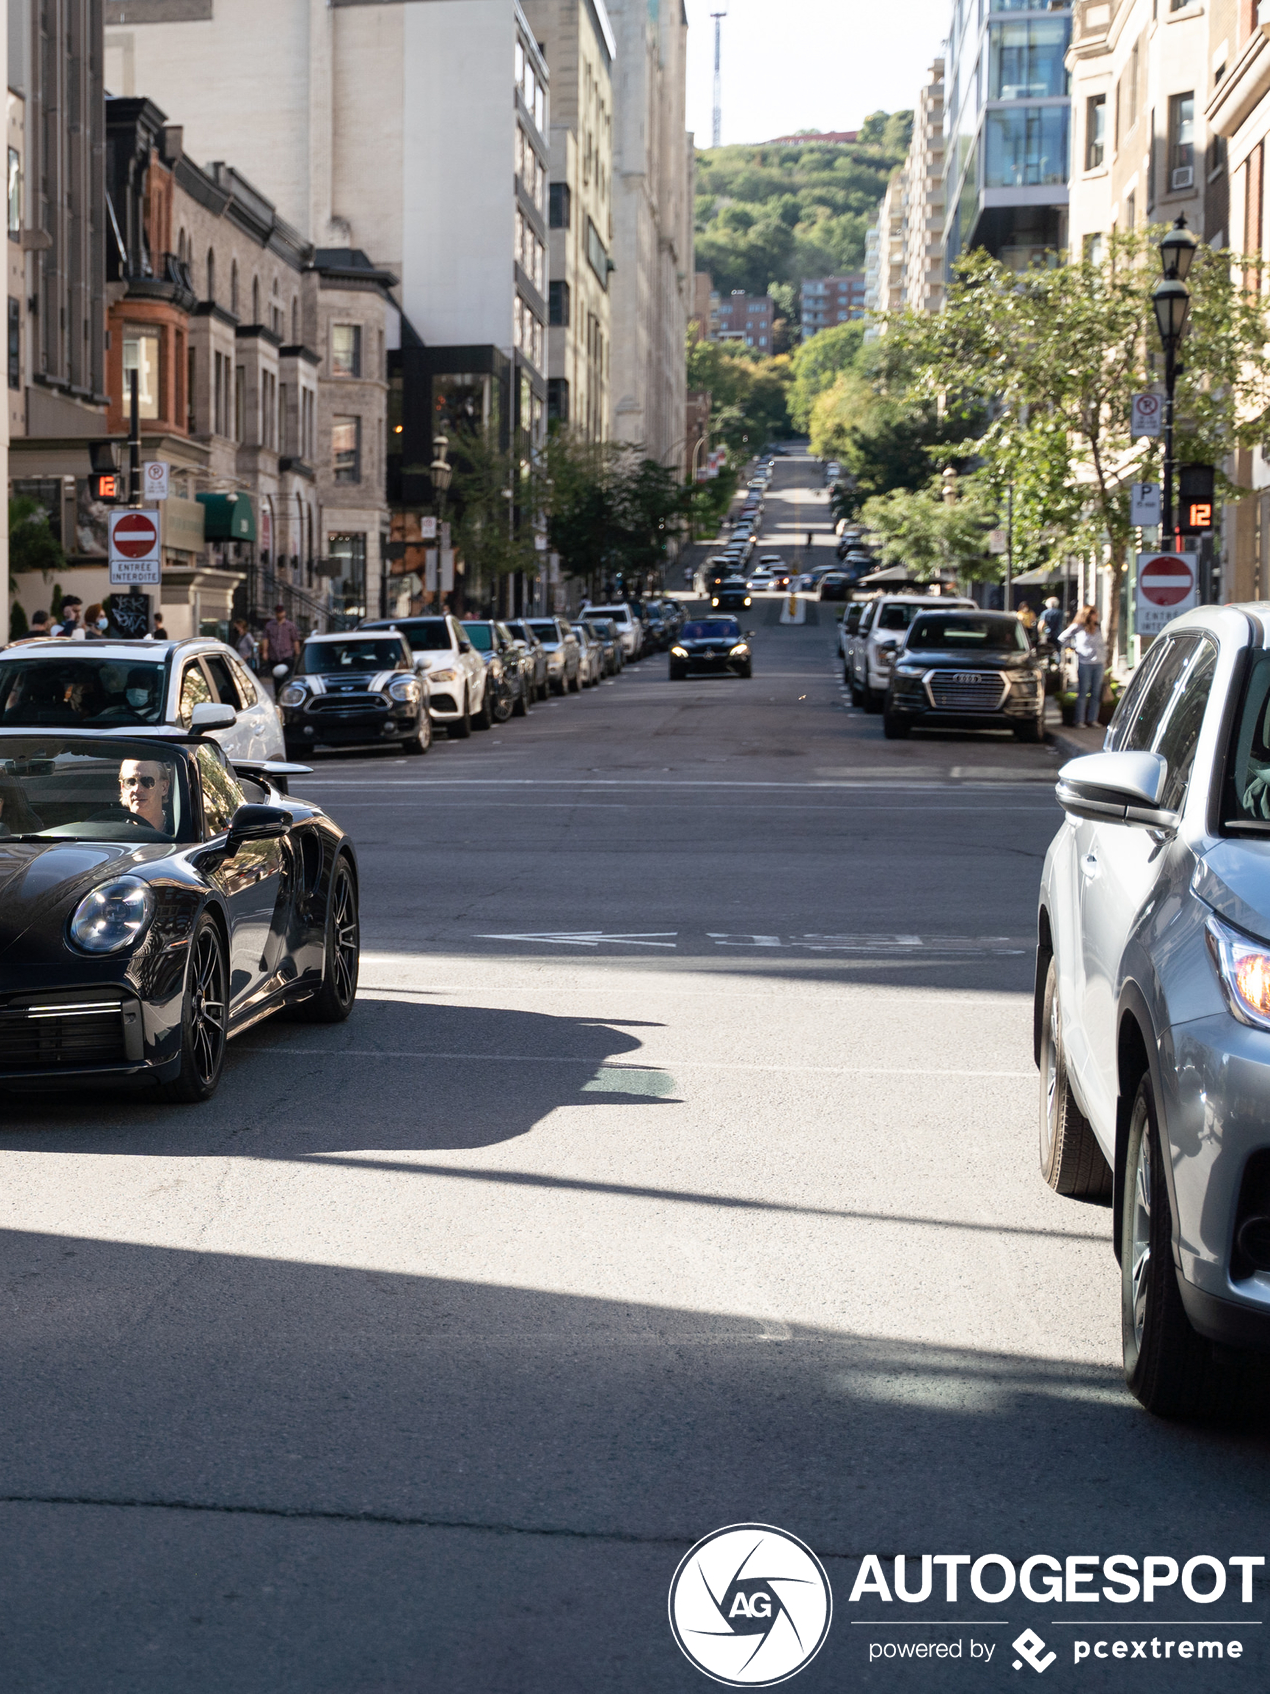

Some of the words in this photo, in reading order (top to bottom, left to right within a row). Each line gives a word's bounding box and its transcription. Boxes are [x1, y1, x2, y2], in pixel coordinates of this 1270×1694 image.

[1190, 504, 1211, 526] 12
[118, 562, 151, 572] ENTRÉE
[112, 573, 157, 581] INTERDITE
[1145, 609, 1184, 621] ENTRÉ
